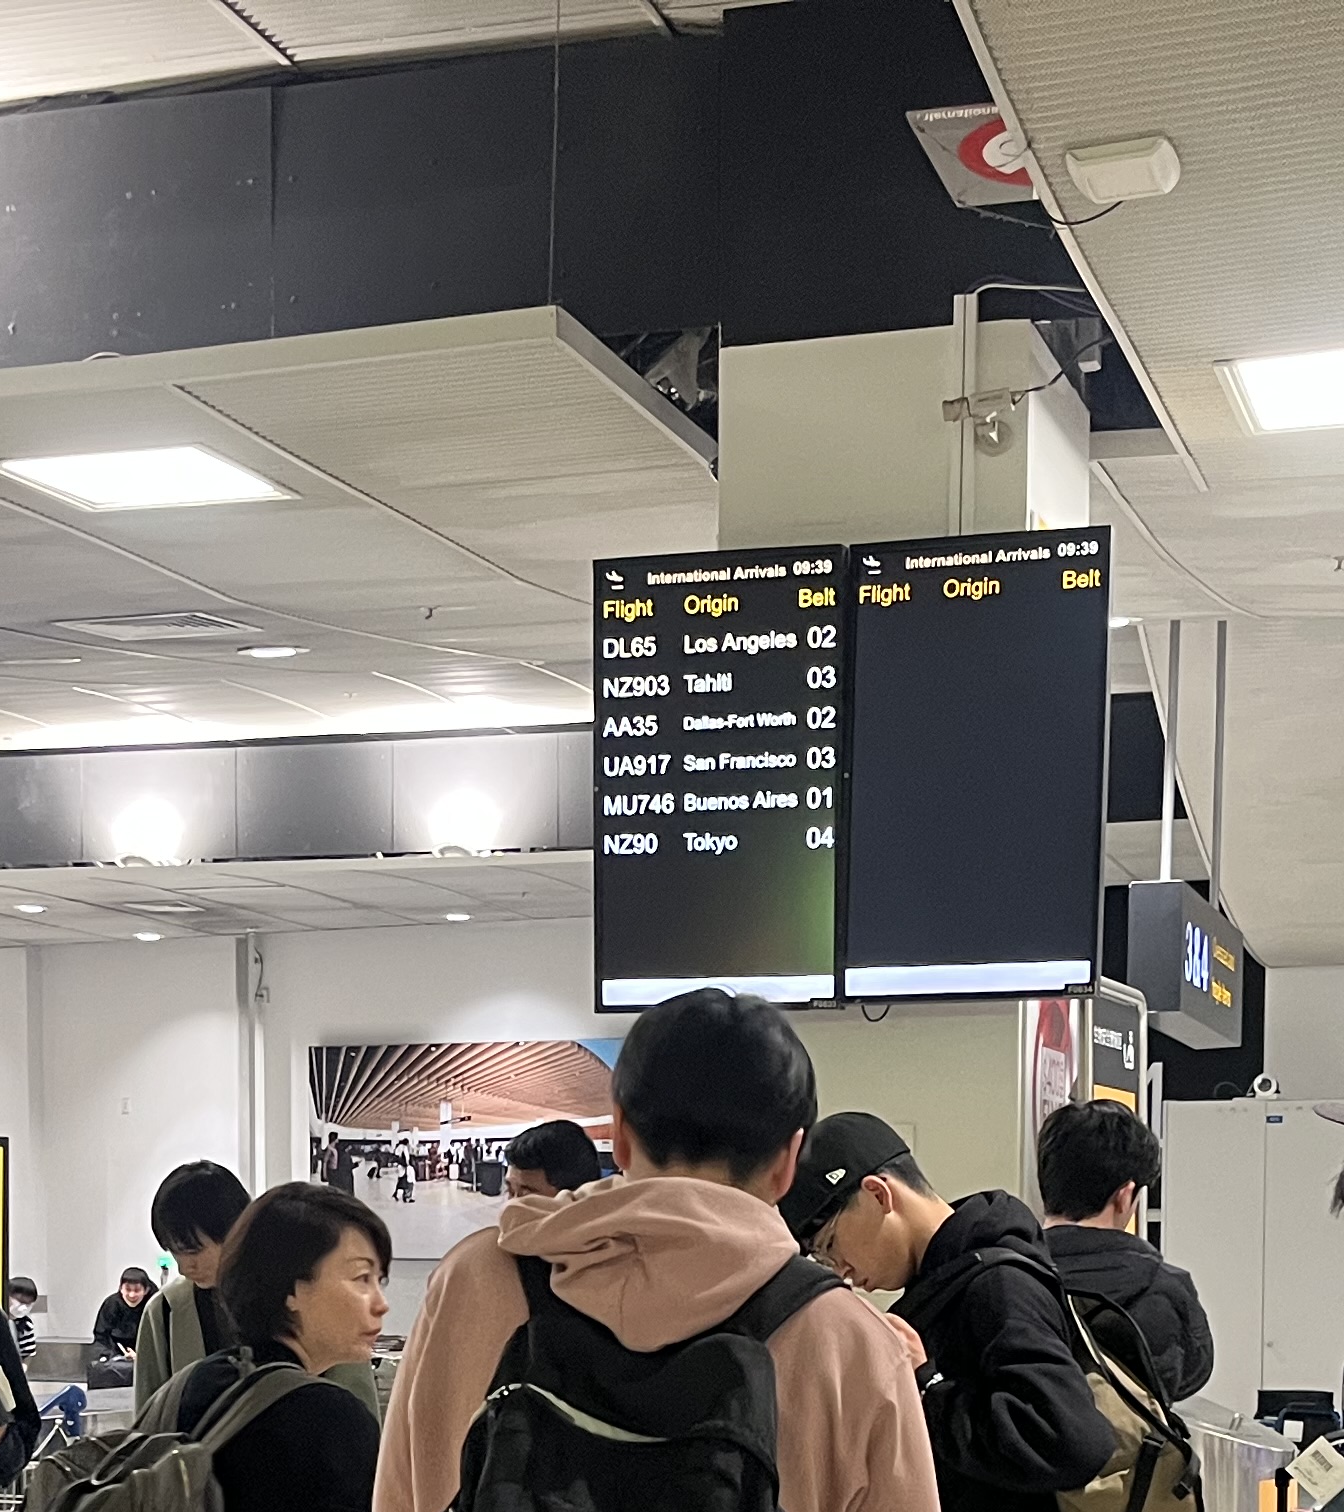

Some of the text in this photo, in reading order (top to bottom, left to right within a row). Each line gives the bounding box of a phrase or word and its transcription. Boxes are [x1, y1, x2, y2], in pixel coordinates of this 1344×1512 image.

[906, 540, 1099, 570] International Arrivals 09:39
[647, 559, 832, 585] International Arrivals 09:39
[859, 569, 1101, 606] Flight Origin Belt
[603, 588, 835, 622] Flight Origin Belt
[603, 625, 836, 658] DL65 Los Angeles 02
[603, 666, 836, 698] NZ903 Tahiti 03
[603, 706, 836, 737] AA35 Dallas-Fort Worth 02
[604, 747, 835, 777] UA917 San Francisco 03
[604, 787, 833, 816] MU746 Buenos Aires 01
[604, 826, 834, 855] NZ90 Tokyo 04
